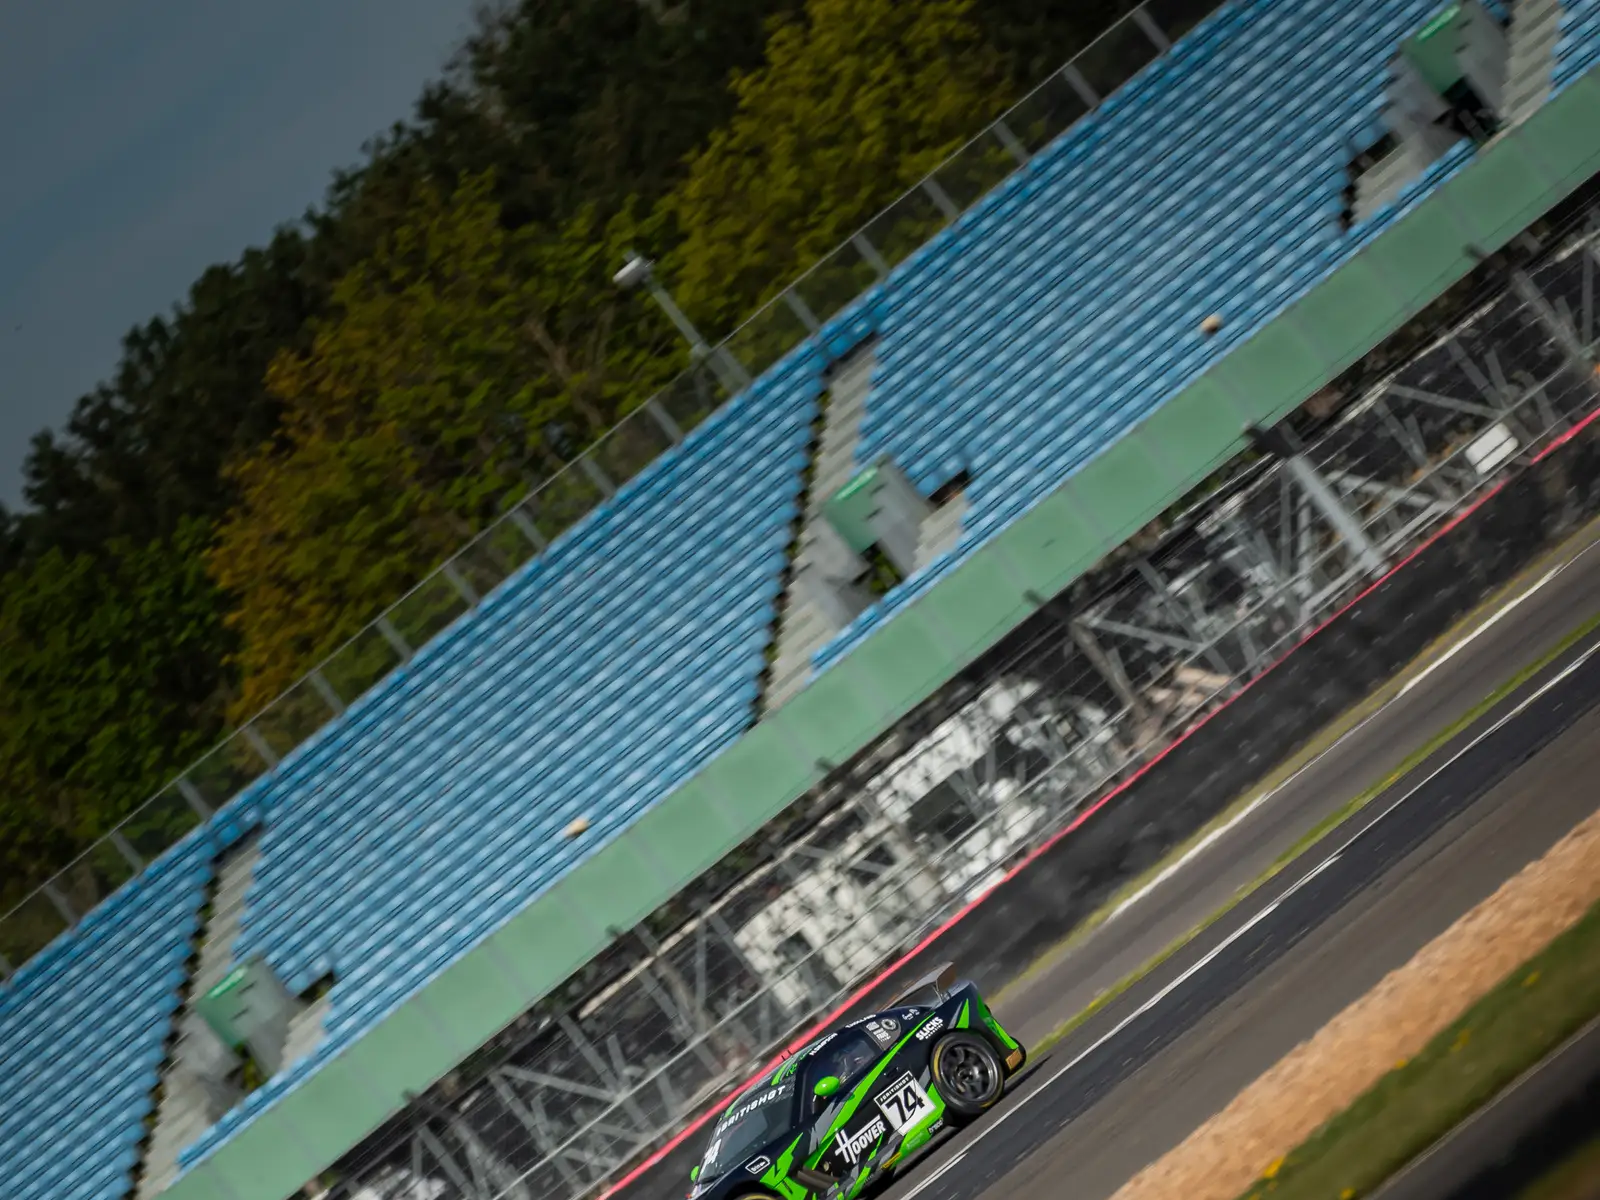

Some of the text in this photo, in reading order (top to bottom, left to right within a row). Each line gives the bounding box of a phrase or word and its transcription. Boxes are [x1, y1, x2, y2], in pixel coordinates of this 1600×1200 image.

[915, 1017, 943, 1040] SLICKS
[885, 1085, 925, 1128] 74
[834, 1114, 887, 1165] HOOVER
